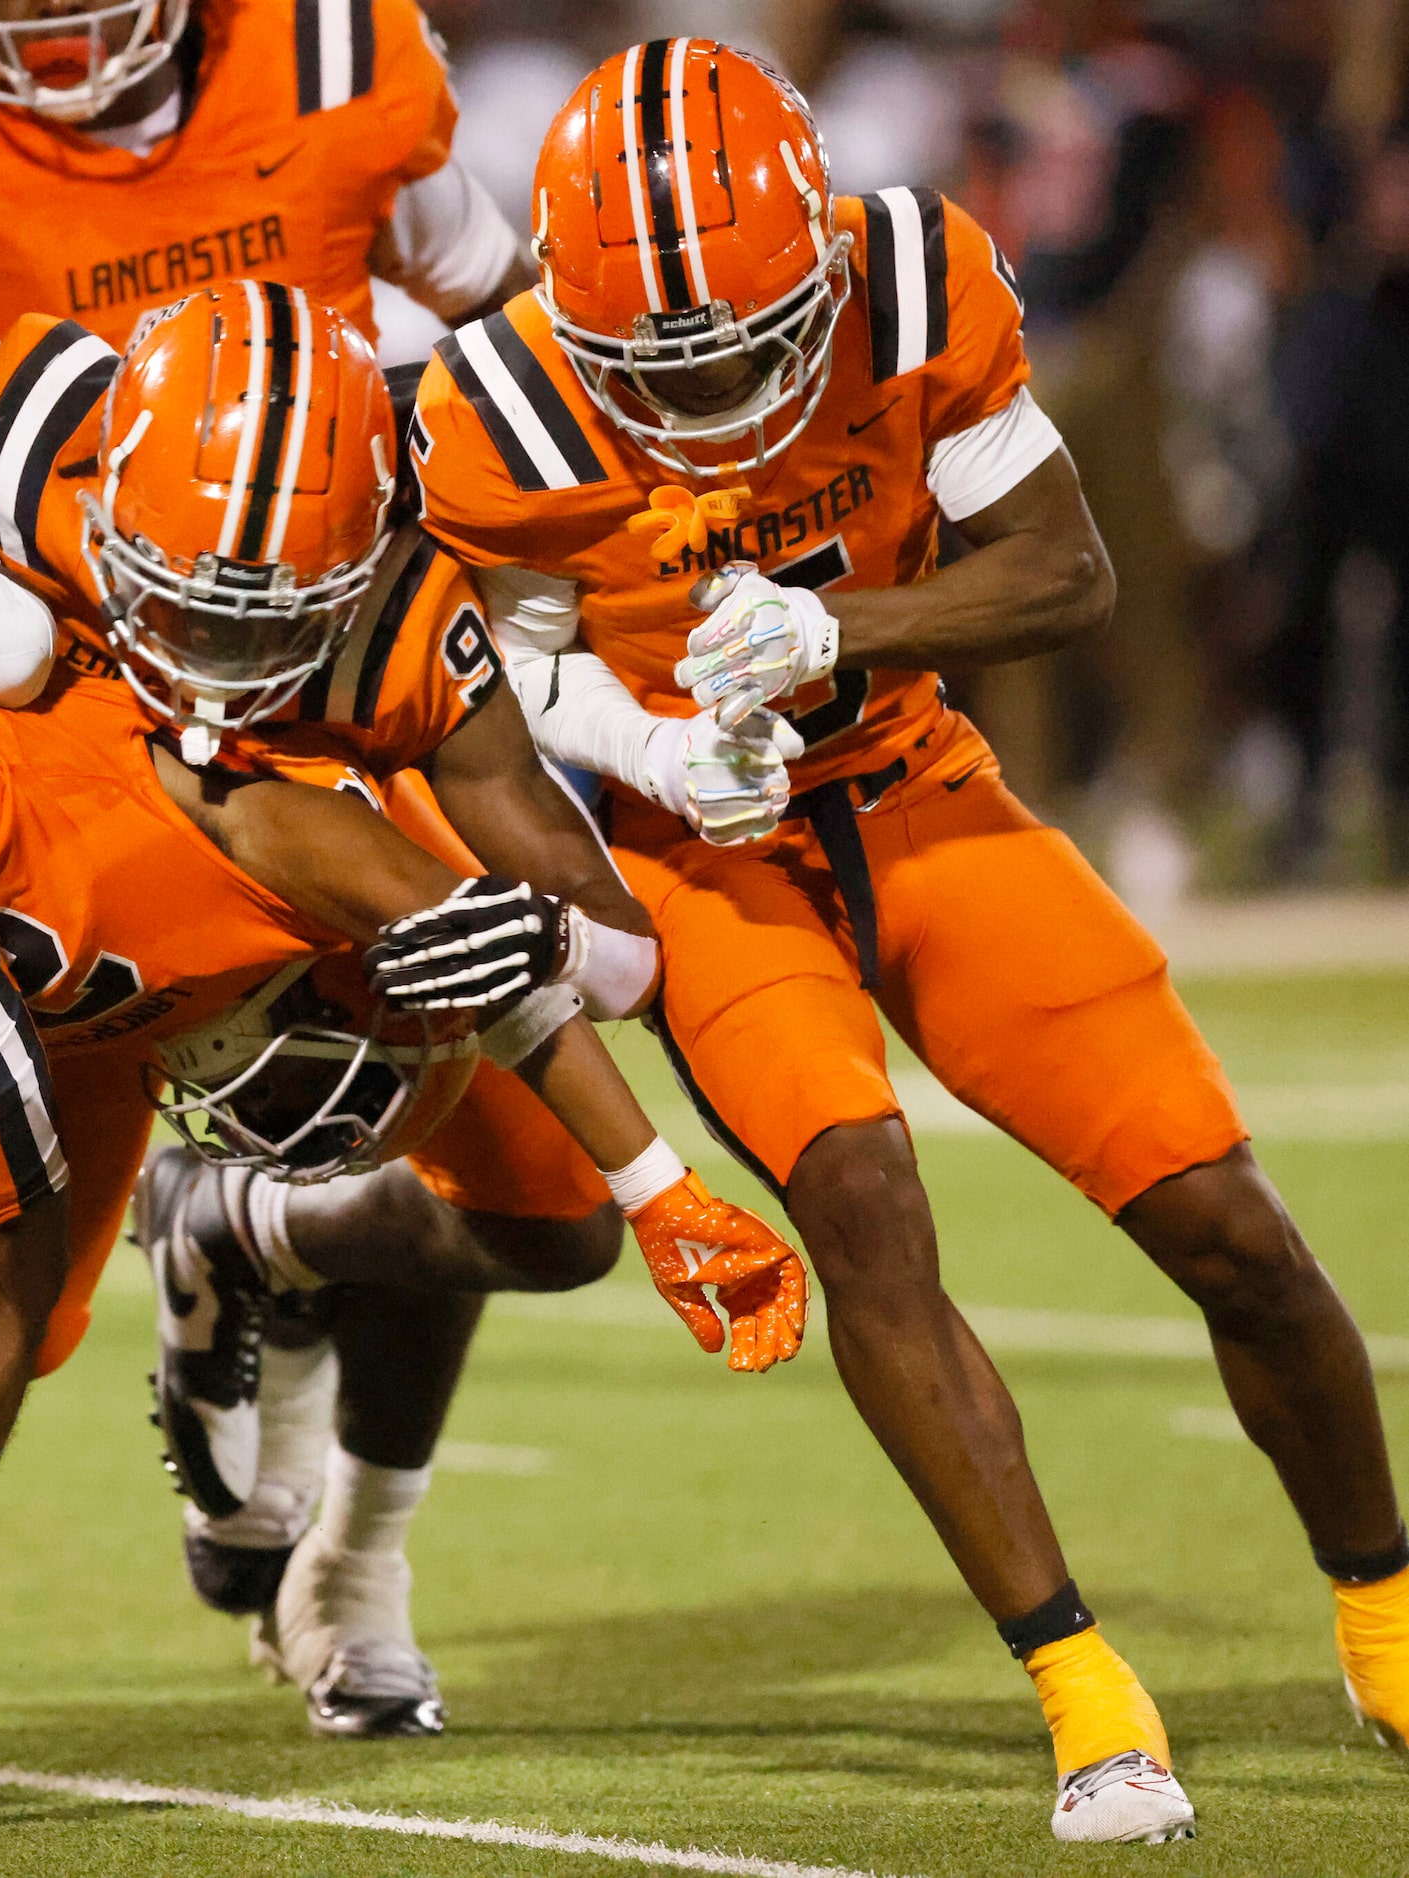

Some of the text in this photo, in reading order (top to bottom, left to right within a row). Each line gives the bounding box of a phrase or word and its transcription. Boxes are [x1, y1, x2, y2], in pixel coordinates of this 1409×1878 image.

[66, 213, 286, 313] LANCASTER
[662, 312, 707, 330] schutt
[440, 602, 505, 708] 9
